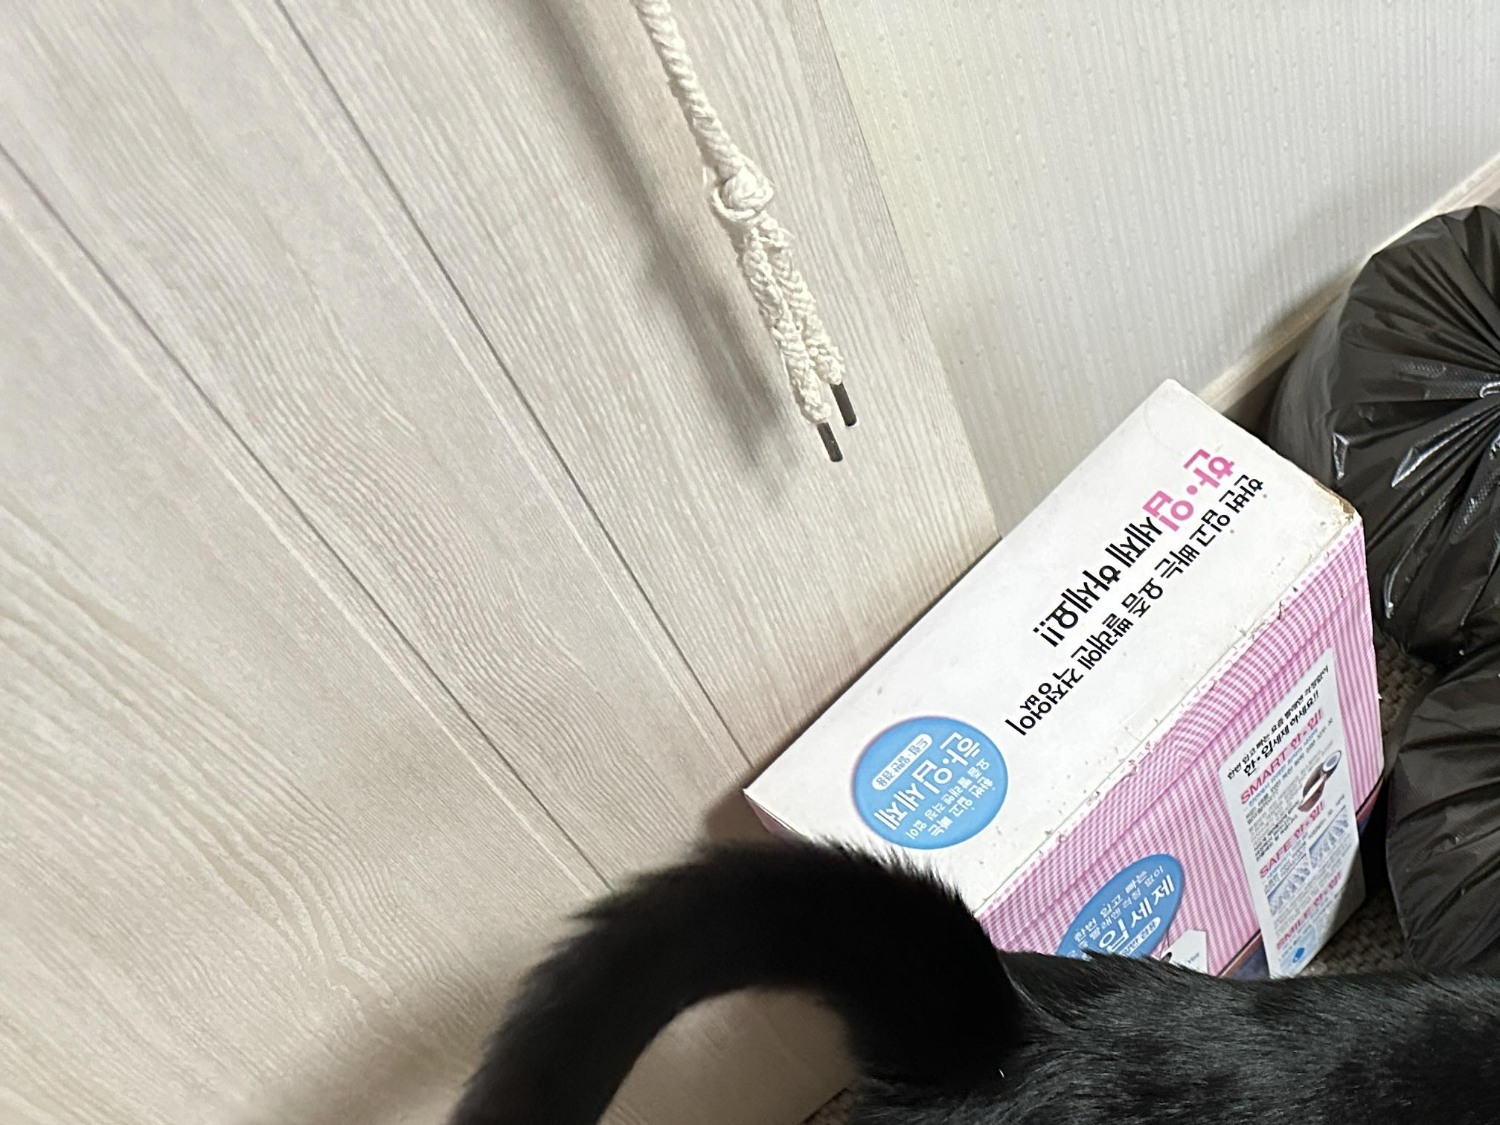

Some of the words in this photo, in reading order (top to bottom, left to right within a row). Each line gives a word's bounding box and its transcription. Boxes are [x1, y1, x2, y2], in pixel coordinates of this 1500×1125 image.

[1218, 474, 1263, 513] 한번
[1188, 508, 1230, 547] 입고
[1154, 543, 1200, 578] 빠는
[1032, 564, 1121, 647] 하세요!!
[1120, 577, 1163, 617] 요즘
[1070, 612, 1133, 670] 빨래엔
[967, 758, 989, 778] 요즘
[970, 777, 992, 797] 한번
[1241, 748, 1288, 804] SMART
[941, 776, 972, 804] 빨래엔
[949, 797, 972, 816] 입고
[928, 817, 952, 835] 빠는
[1259, 841, 1292, 877] SAFE
[1074, 918, 1097, 941] 한번
[1100, 894, 1123, 918] 입고
[1125, 871, 1148, 894] 빠는
[1098, 874, 1175, 953] 입세제
